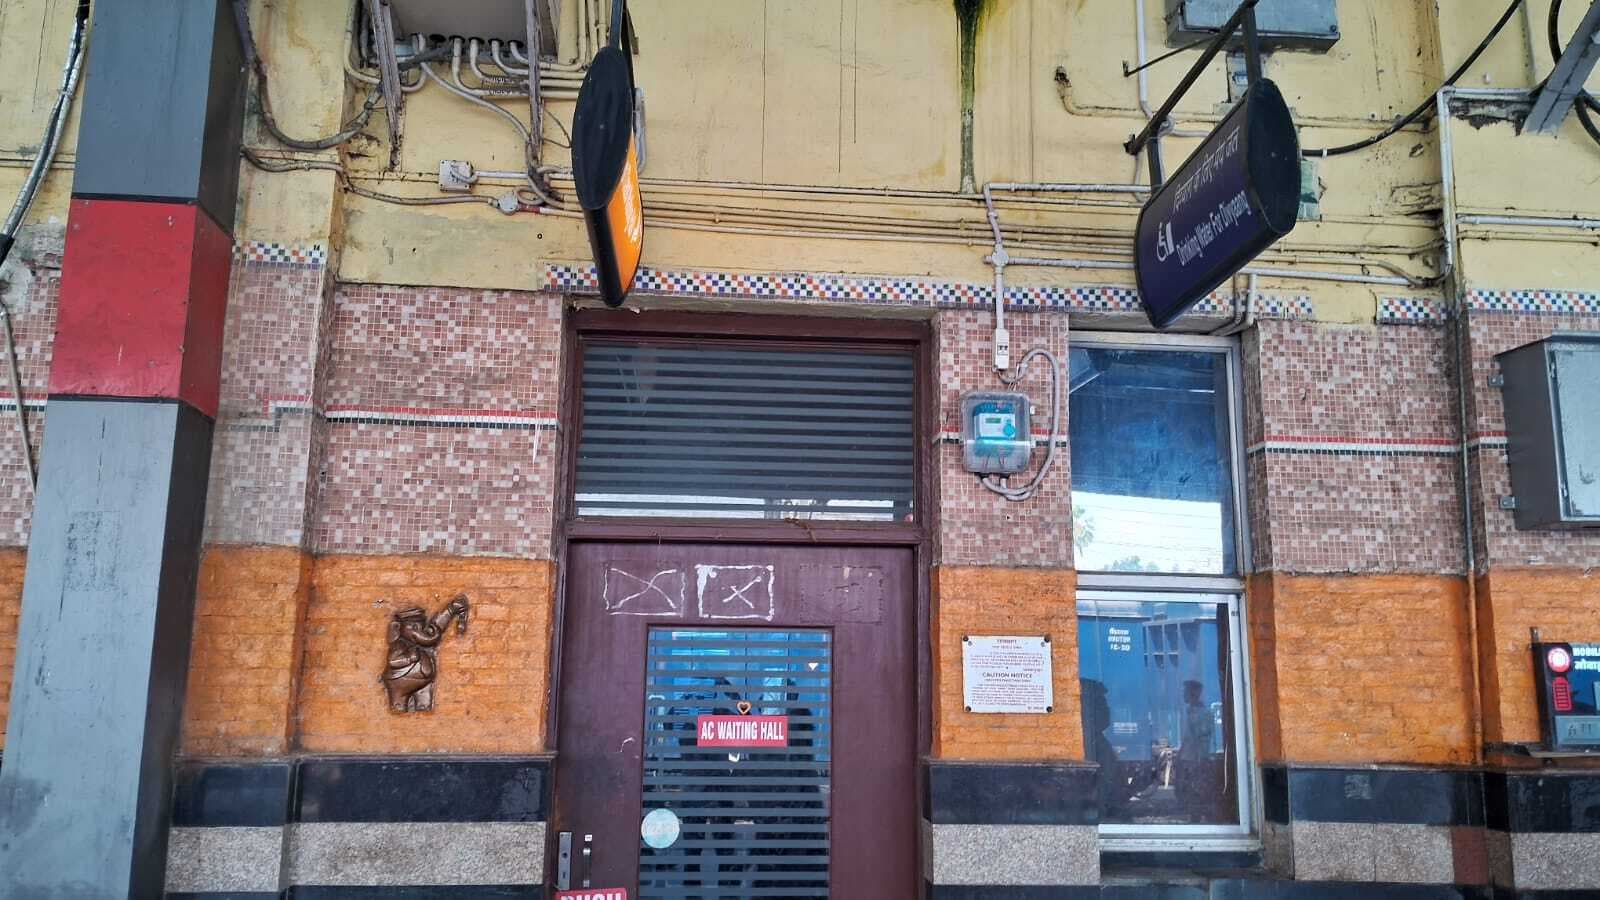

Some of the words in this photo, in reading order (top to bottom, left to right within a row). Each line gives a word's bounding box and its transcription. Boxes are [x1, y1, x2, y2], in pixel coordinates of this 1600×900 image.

[1176, 234, 1203, 266] Drinking
[1195, 221, 1215, 248] Water
[1209, 212, 1224, 236] For
[982, 671, 1010, 679] CAUTION
[701, 721, 715, 740] AC
[717, 721, 758, 740] WAITING
[760, 721, 785, 740] HALL
